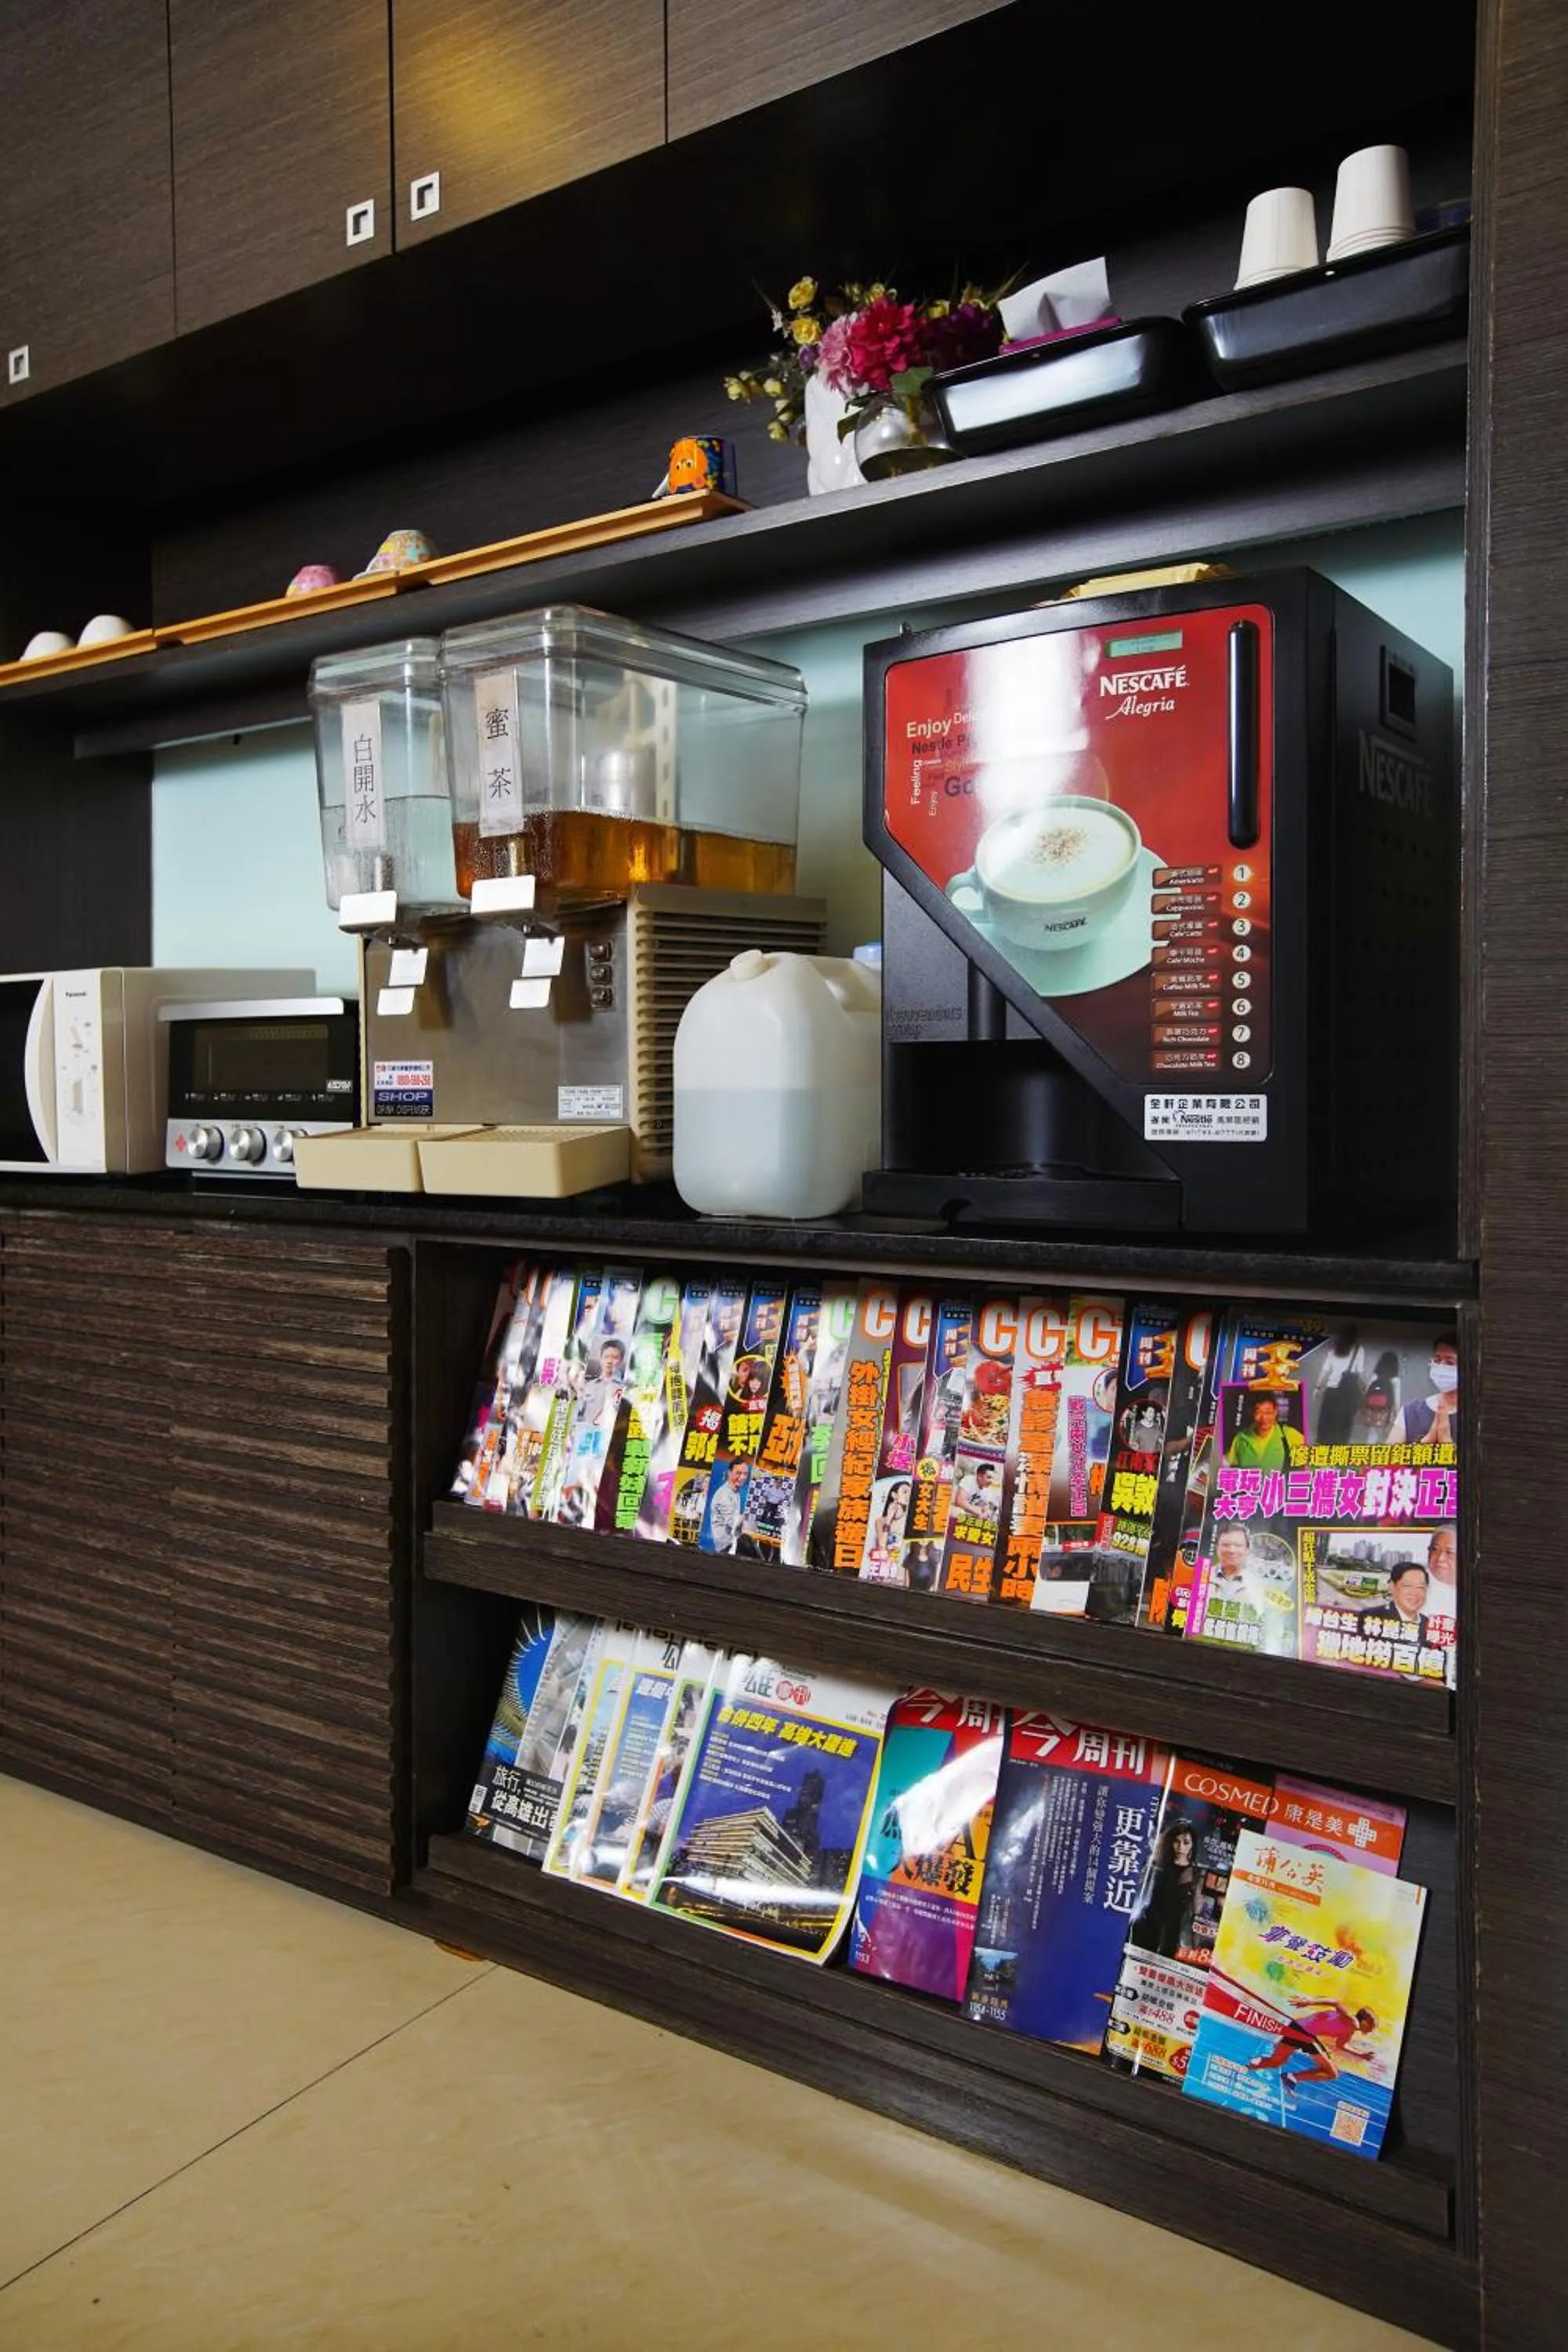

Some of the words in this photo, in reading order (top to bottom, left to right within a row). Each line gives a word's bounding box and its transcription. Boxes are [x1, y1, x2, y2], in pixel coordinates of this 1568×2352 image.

[1100, 665, 1187, 696] NESCAFÉ
[1105, 695, 1174, 720] Alegria
[906, 717, 952, 739] Enjoy
[485, 709, 511, 798] 蜜茶
[354, 734, 376, 823] 白開水
[378, 1091, 428, 1102] SHOP
[946, 1552, 994, 1595] 民生
[1011, 1711, 1145, 1775] 今周刊
[1185, 1772, 1279, 1816] COSMED
[1285, 1803, 1344, 1836] 康是美
[1103, 1804, 1147, 1915] 更靠近
[1233, 2003, 1283, 2034] FINISH
